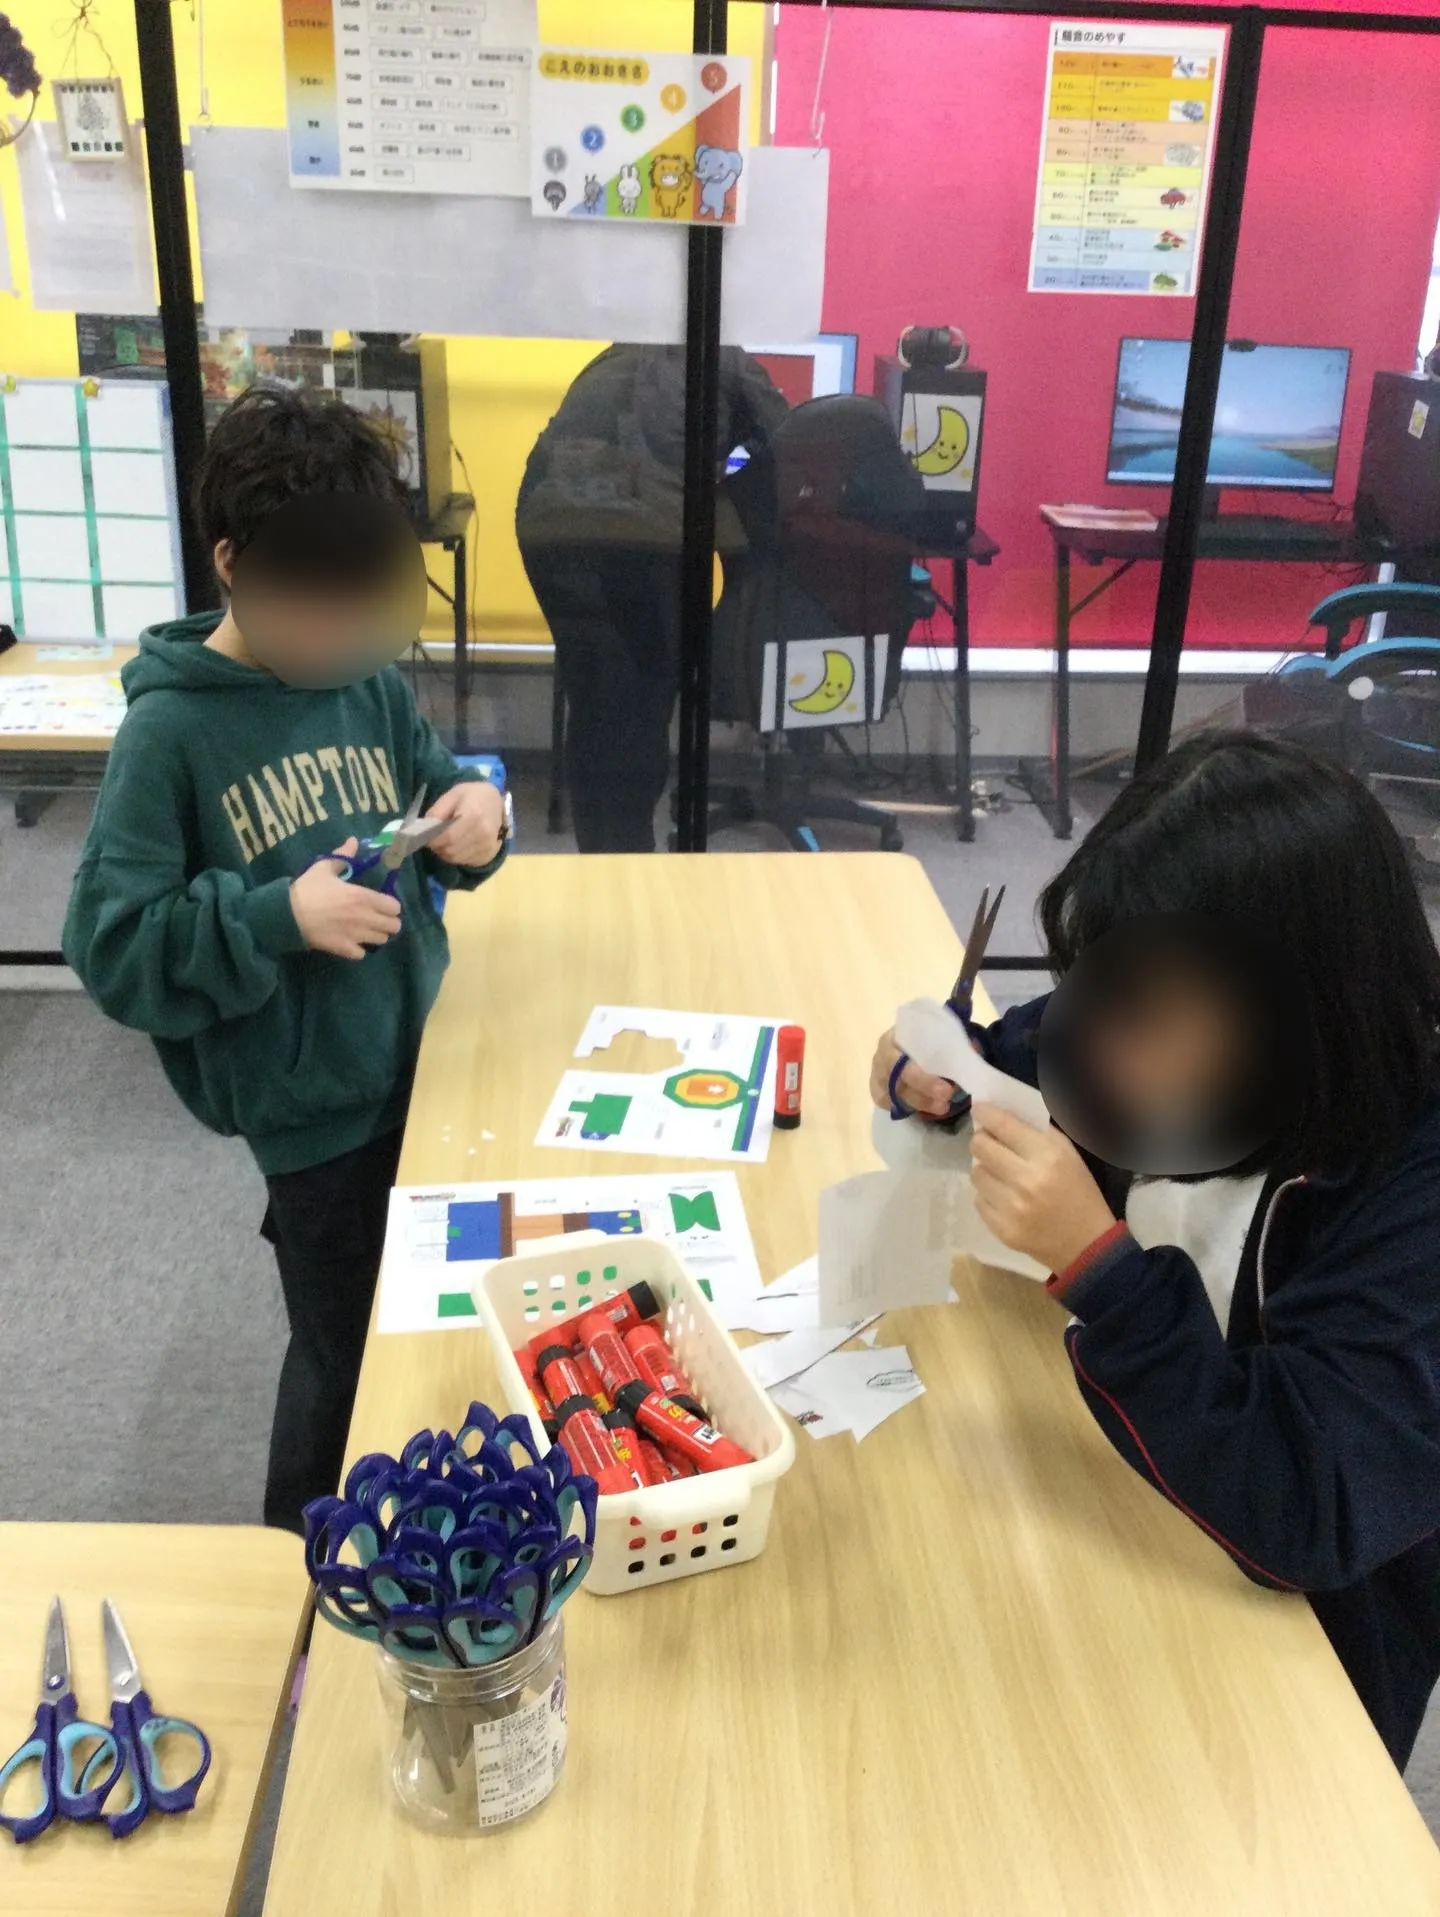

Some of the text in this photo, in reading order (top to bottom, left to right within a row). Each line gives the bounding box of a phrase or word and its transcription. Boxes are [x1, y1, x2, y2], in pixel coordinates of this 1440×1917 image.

[545, 60, 643, 79] こえのおおきさ
[710, 71, 719, 83] 5
[669, 91, 678, 105] 4
[630, 111, 639, 122] 3
[589, 133, 598, 146] 2
[222, 745, 400, 865] HAMPTON
